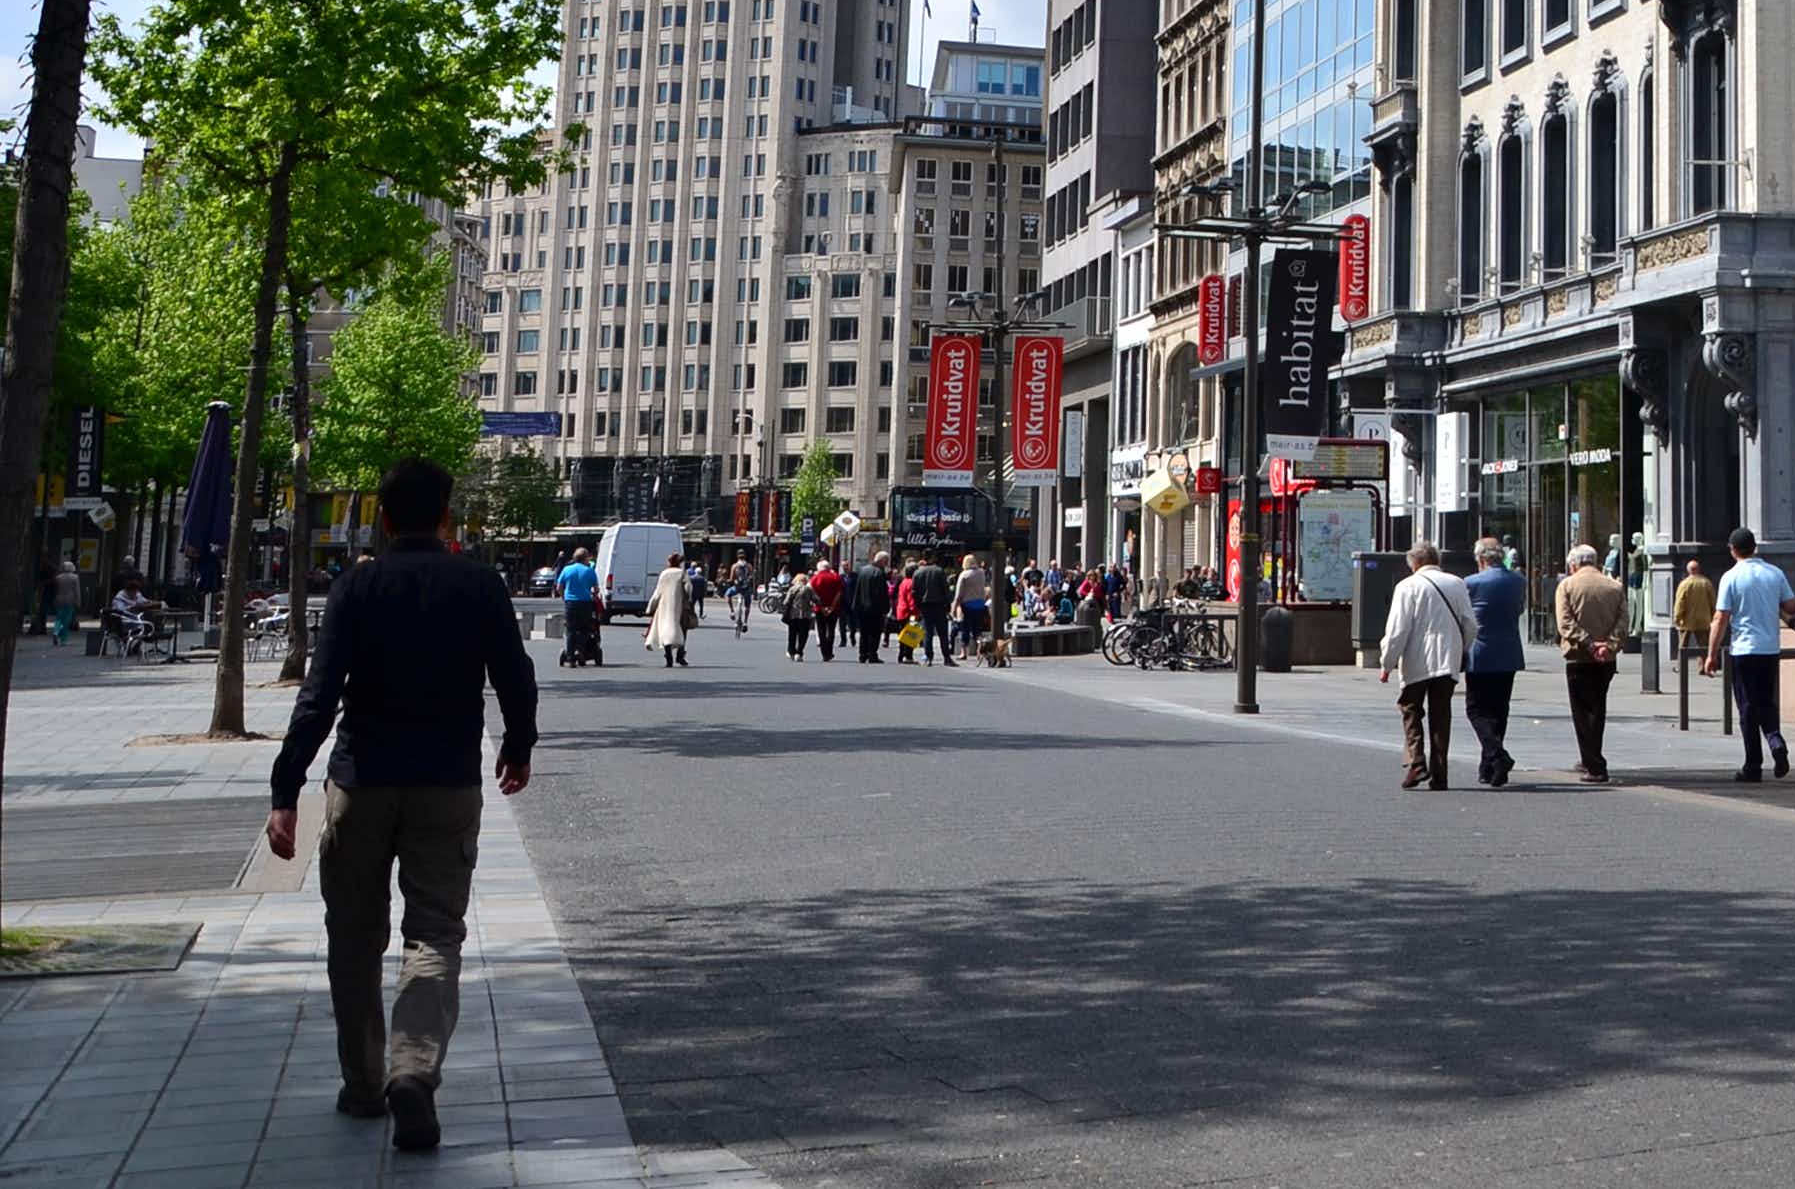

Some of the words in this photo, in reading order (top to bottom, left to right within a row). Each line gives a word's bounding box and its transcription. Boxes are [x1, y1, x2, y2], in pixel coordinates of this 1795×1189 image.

[1349, 222, 1365, 296] Kruidvat
[1205, 280, 1220, 344] Kruidvat
[1280, 280, 1319, 408] habitat
[941, 349, 966, 436] Kruidvat
[1025, 349, 1049, 436] Kruidvat
[78, 406, 94, 487] DIESEL
[1589, 448, 1612, 464] MODA
